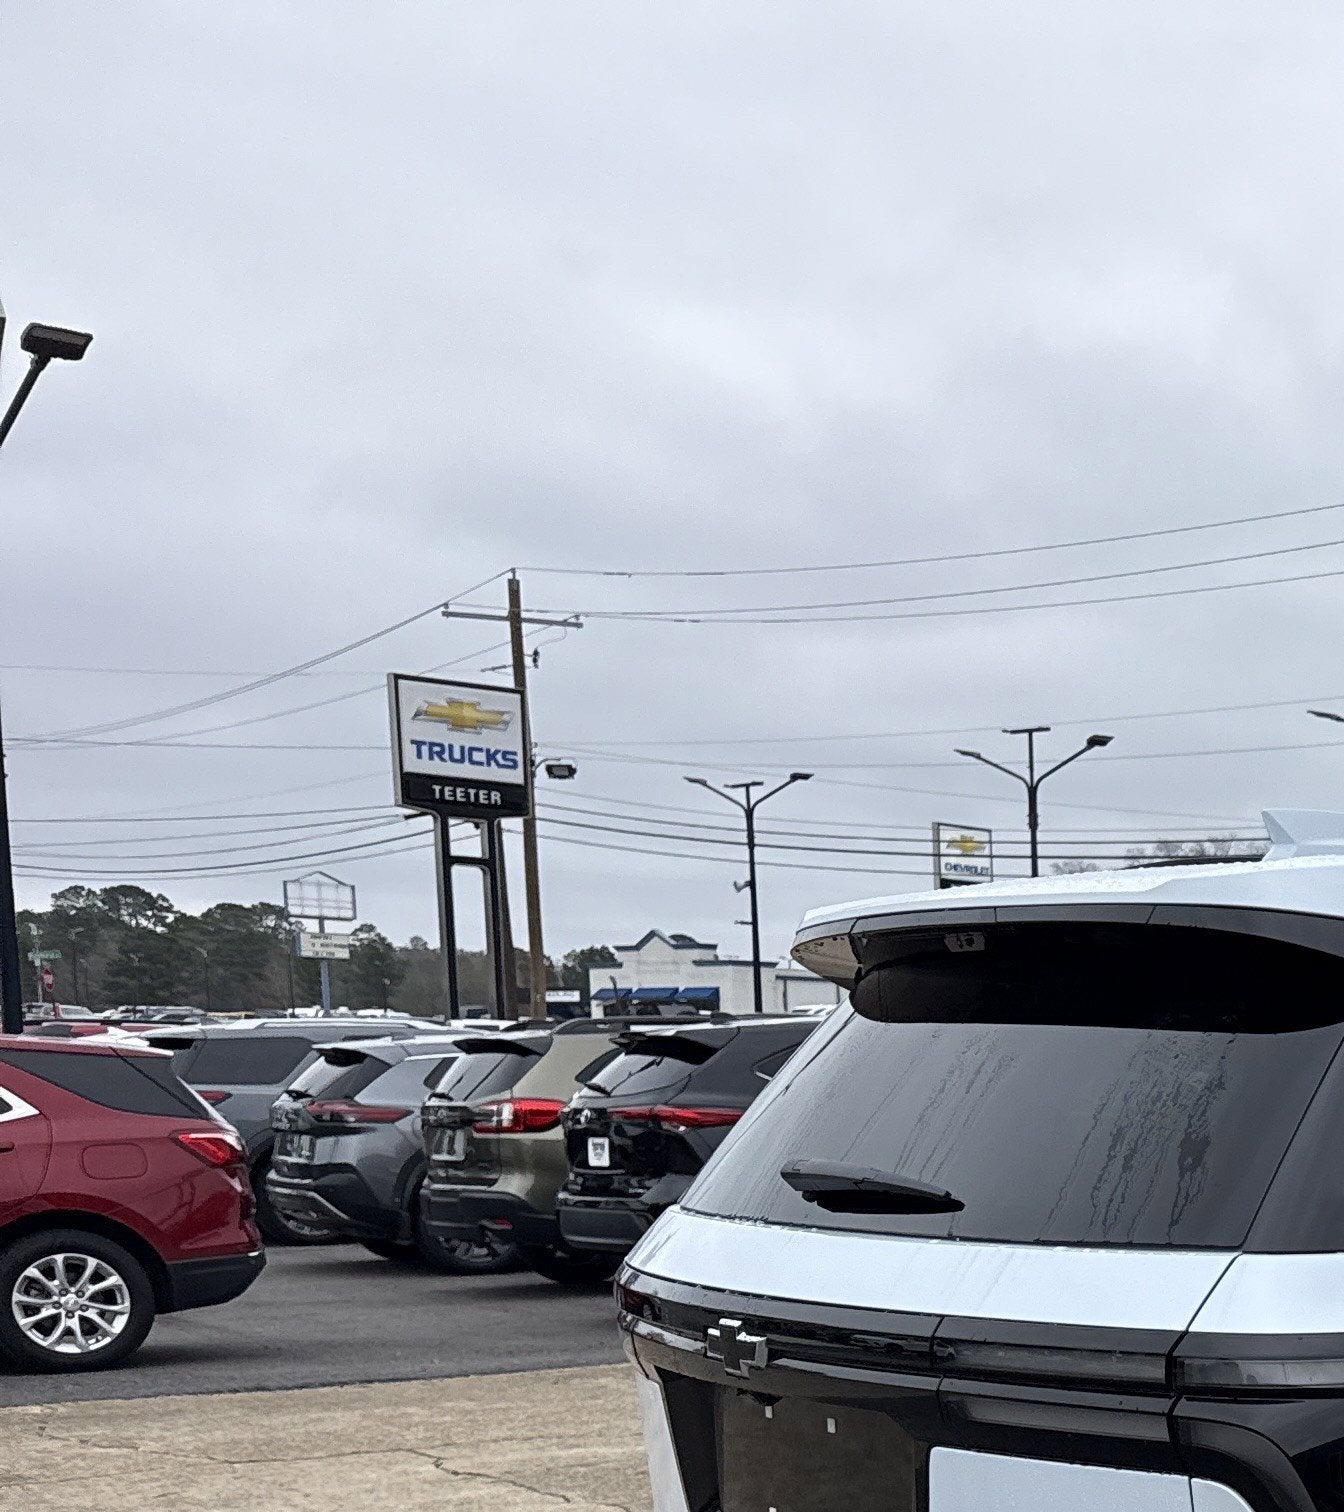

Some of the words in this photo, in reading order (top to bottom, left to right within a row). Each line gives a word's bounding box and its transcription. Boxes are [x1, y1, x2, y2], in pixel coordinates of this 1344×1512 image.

[411, 739, 519, 770] TRUCKS
[431, 784, 502, 805] TEETER
[945, 862, 990, 876] CHEVROLET
